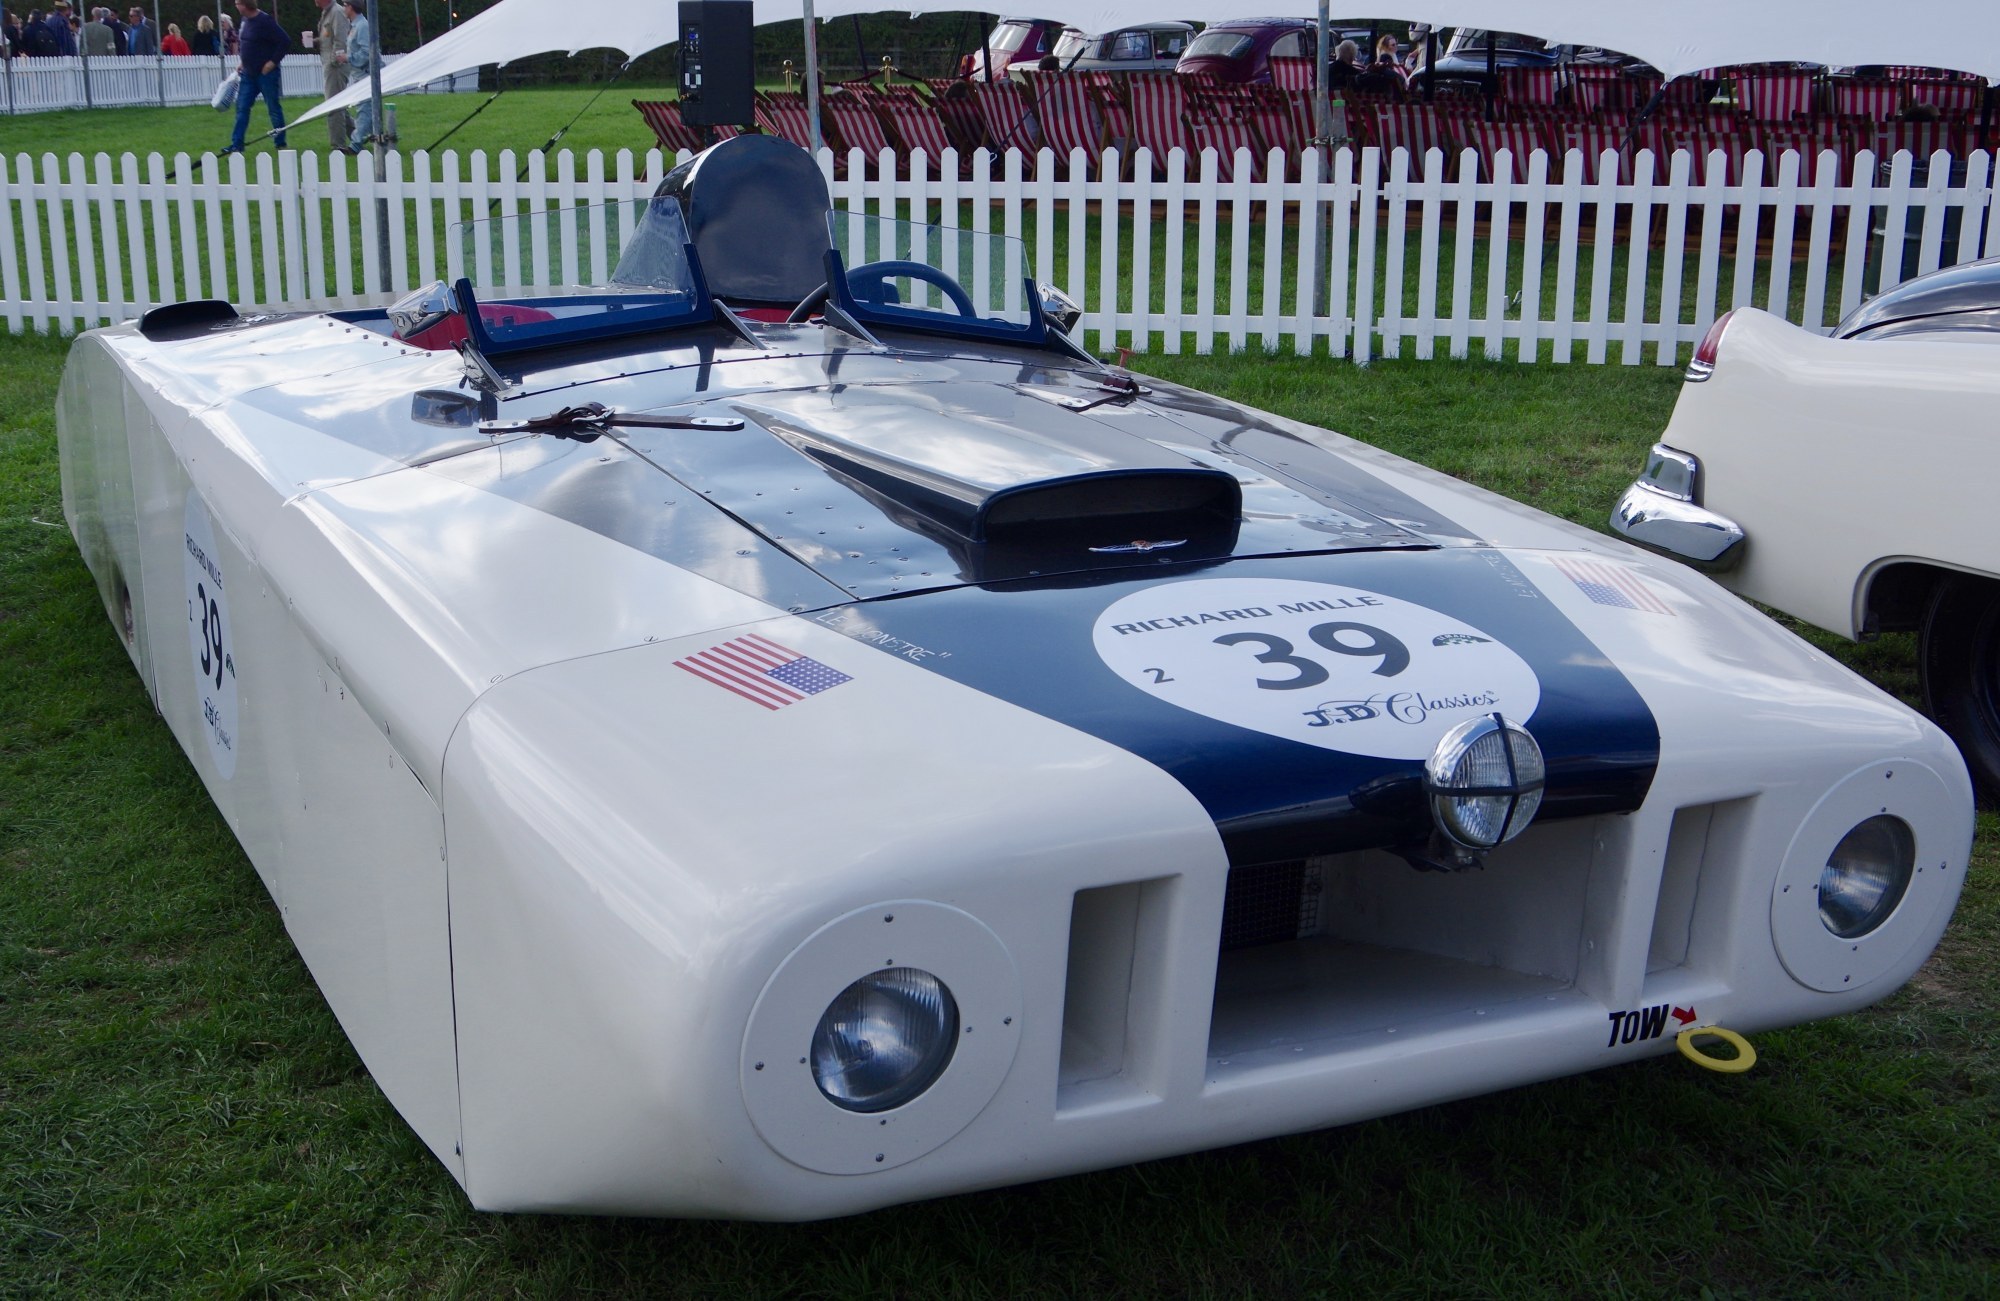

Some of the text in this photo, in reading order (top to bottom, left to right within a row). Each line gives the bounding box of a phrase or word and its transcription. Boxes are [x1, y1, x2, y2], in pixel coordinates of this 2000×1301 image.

[197, 582, 223, 691] 39
[1111, 596, 1384, 635] RICHARD MILLE
[1143, 667, 1176, 684] 2
[1212, 620, 1411, 691] 39
[1608, 1004, 1669, 1048] TOW
